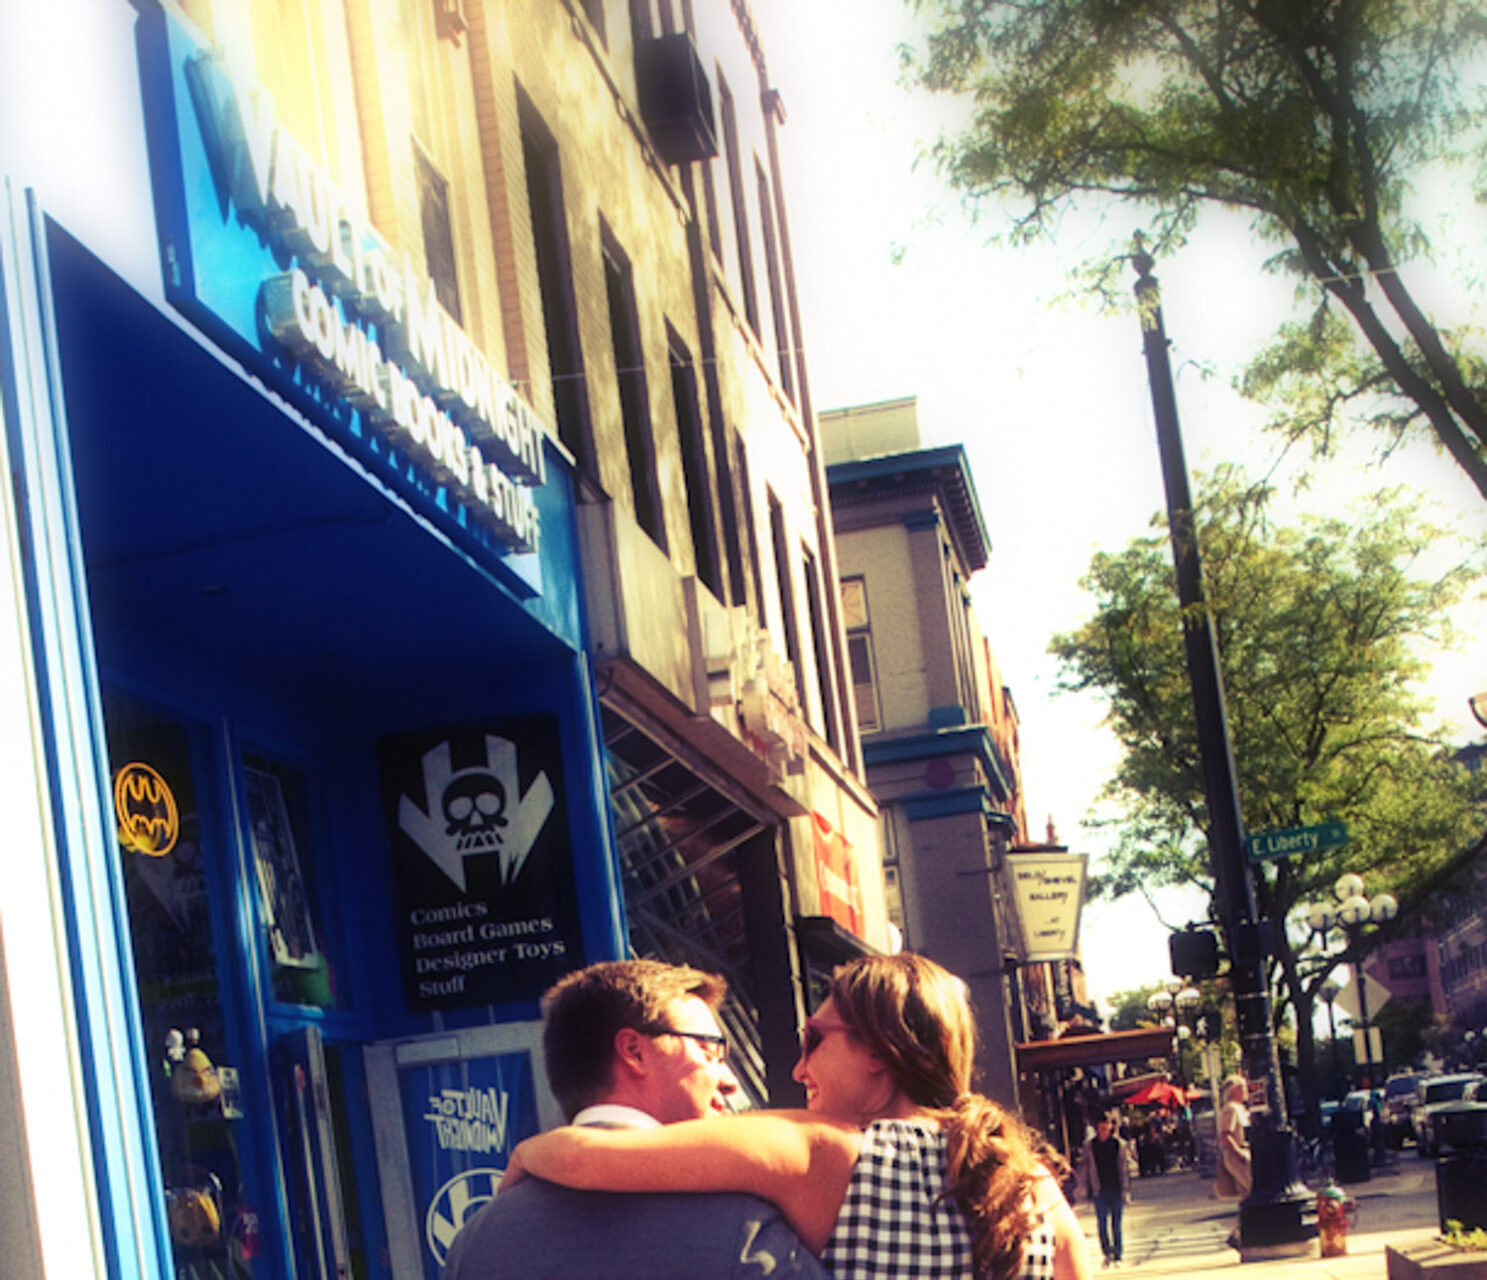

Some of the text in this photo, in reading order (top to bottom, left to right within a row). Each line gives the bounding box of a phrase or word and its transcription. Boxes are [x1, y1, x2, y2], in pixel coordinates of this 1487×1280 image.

[403, 246, 547, 485] MIDNIGHT
[291, 267, 541, 554] COMIC BOOKS & STUFF
[1267, 832, 1319, 852] Liberty
[410, 902, 488, 925] Comics
[413, 917, 554, 949] Board Games
[416, 940, 566, 974] Designer Toys
[418, 974, 467, 998] Stuff
